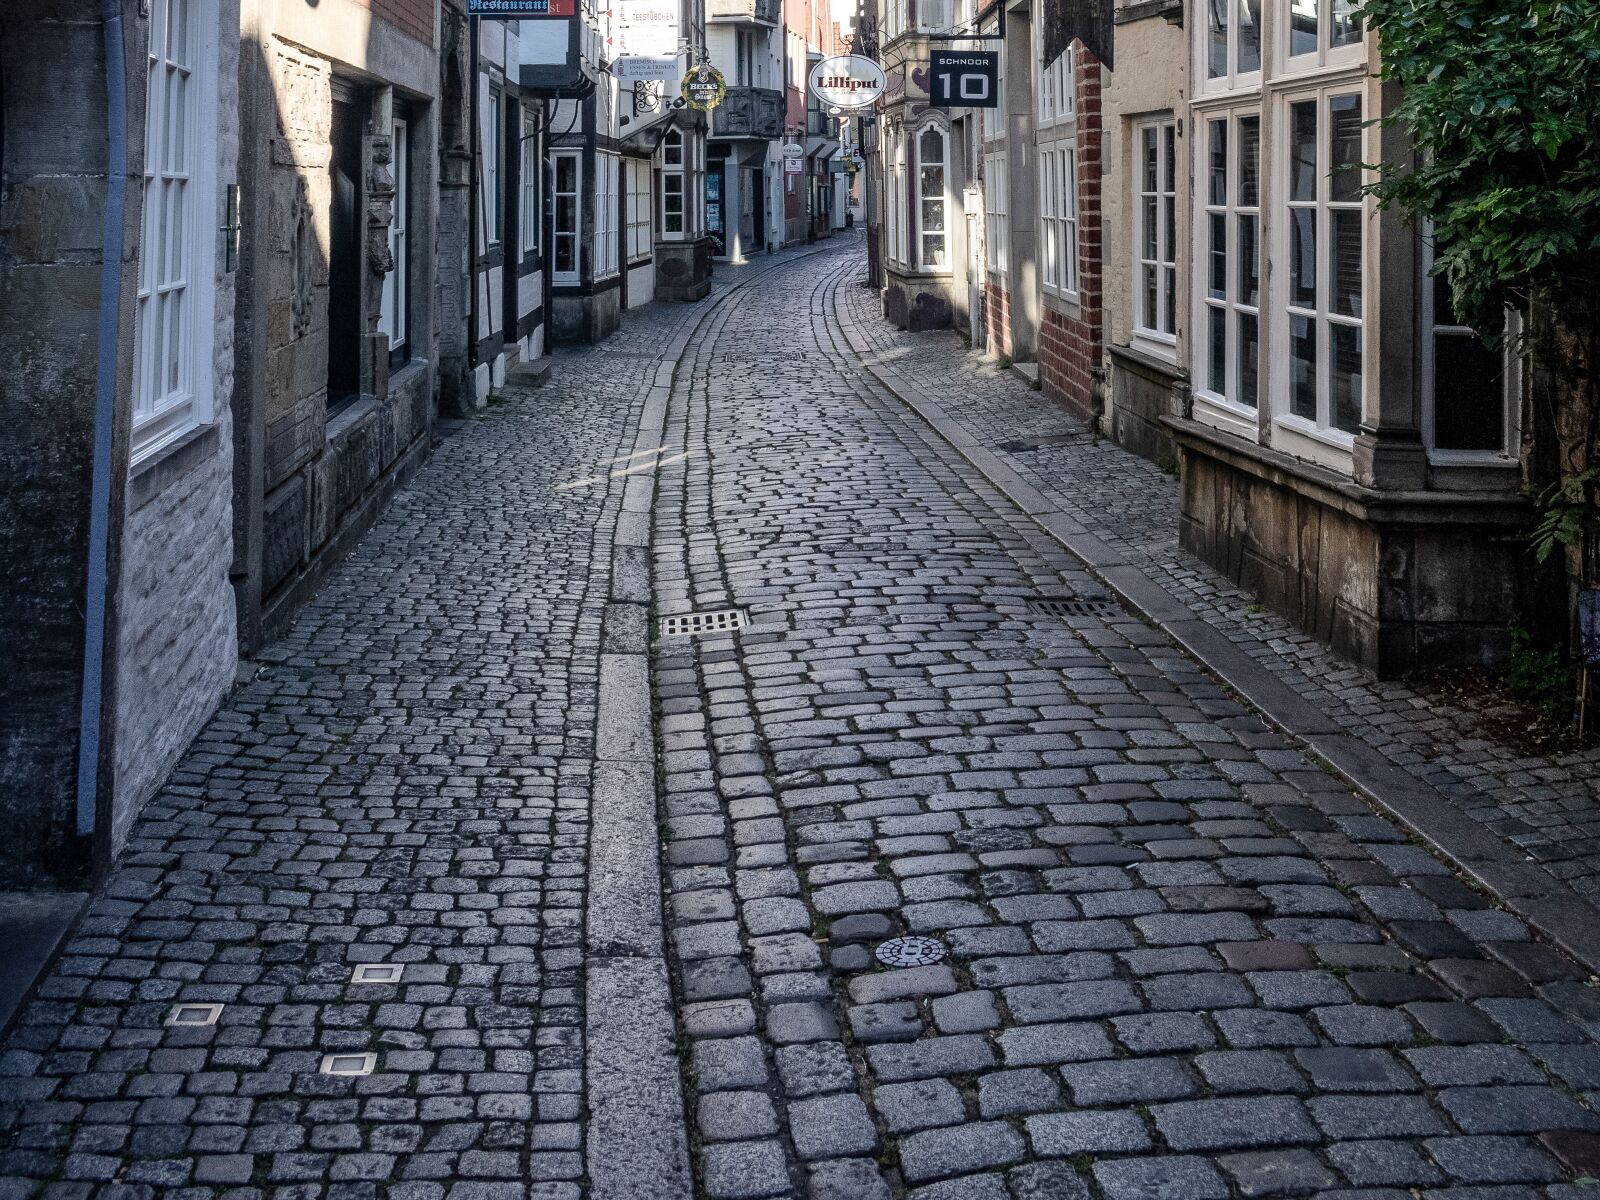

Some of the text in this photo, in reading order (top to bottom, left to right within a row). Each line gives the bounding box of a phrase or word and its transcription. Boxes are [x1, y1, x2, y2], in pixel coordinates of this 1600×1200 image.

[632, 10, 674, 21] TEESTÜBCHEN
[939, 58, 989, 66] SCHNOOR
[817, 76, 879, 91] Lilliput
[938, 73, 989, 100] 10
